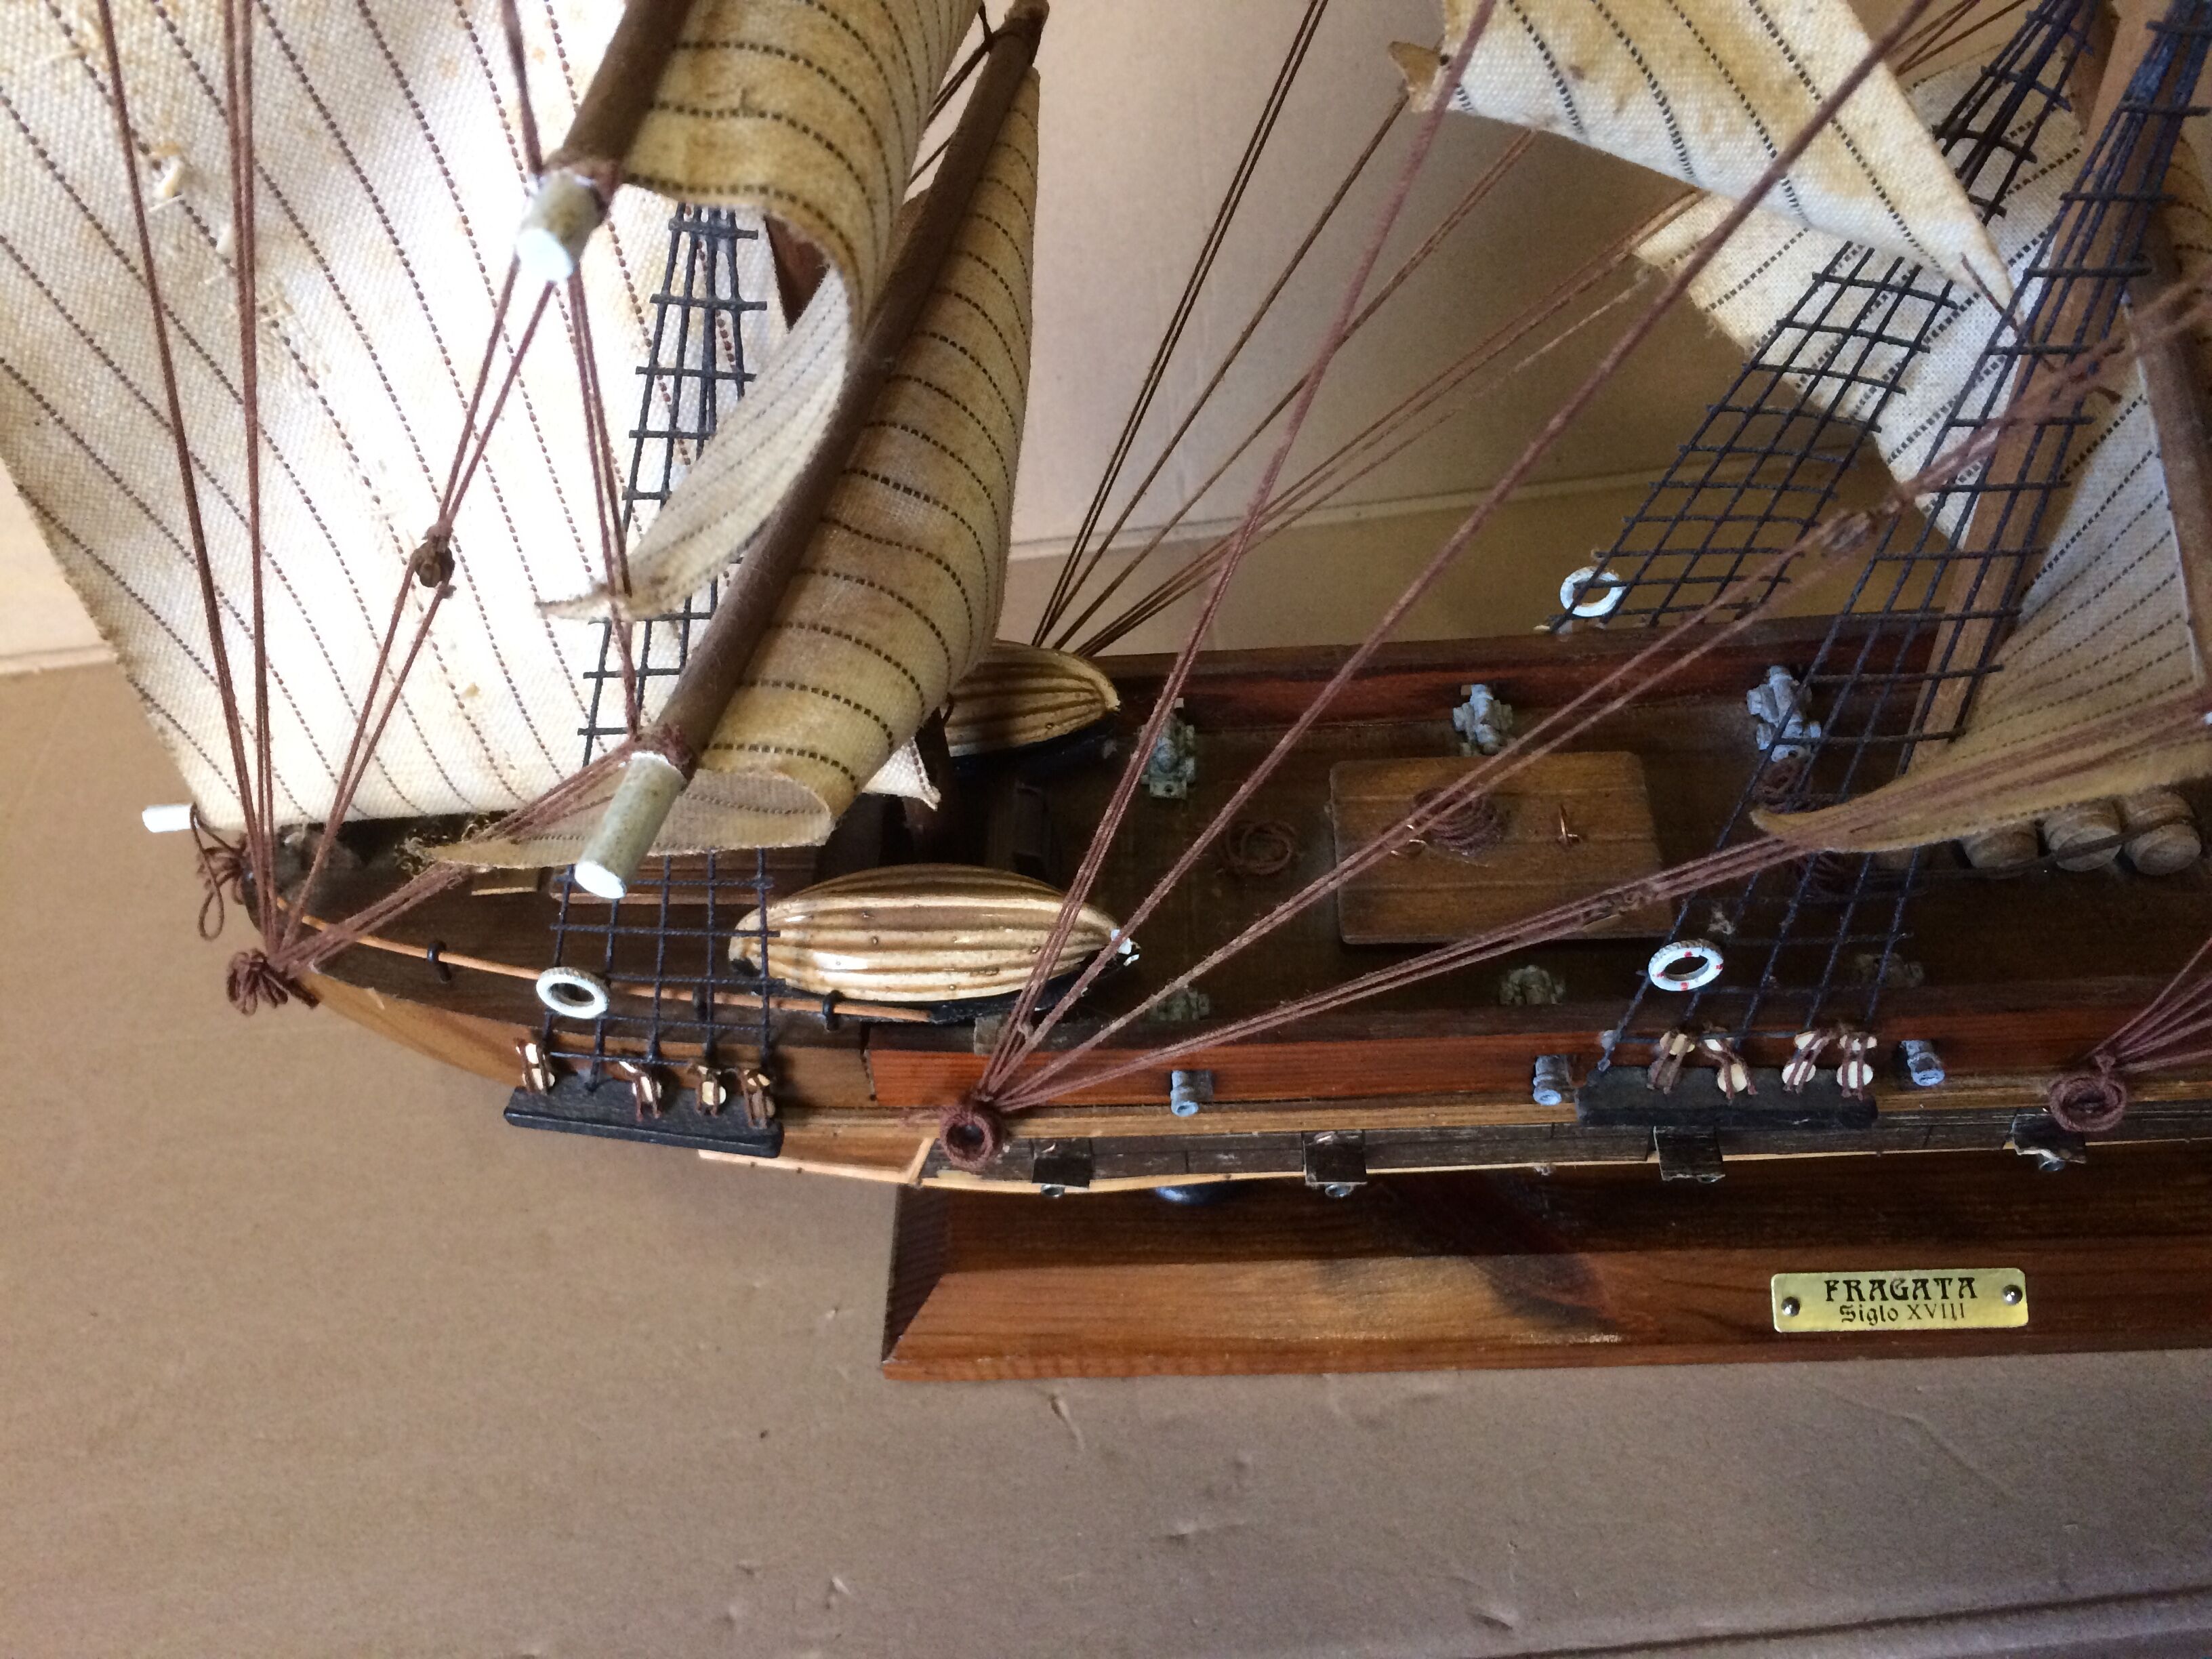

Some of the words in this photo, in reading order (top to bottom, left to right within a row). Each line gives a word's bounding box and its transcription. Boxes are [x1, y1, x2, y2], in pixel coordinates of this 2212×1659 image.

[1824, 1277, 1978, 1302] FRAGATA
[1839, 1305, 1899, 1326] Siglo
[1907, 1303, 1965, 1321] XVIII
